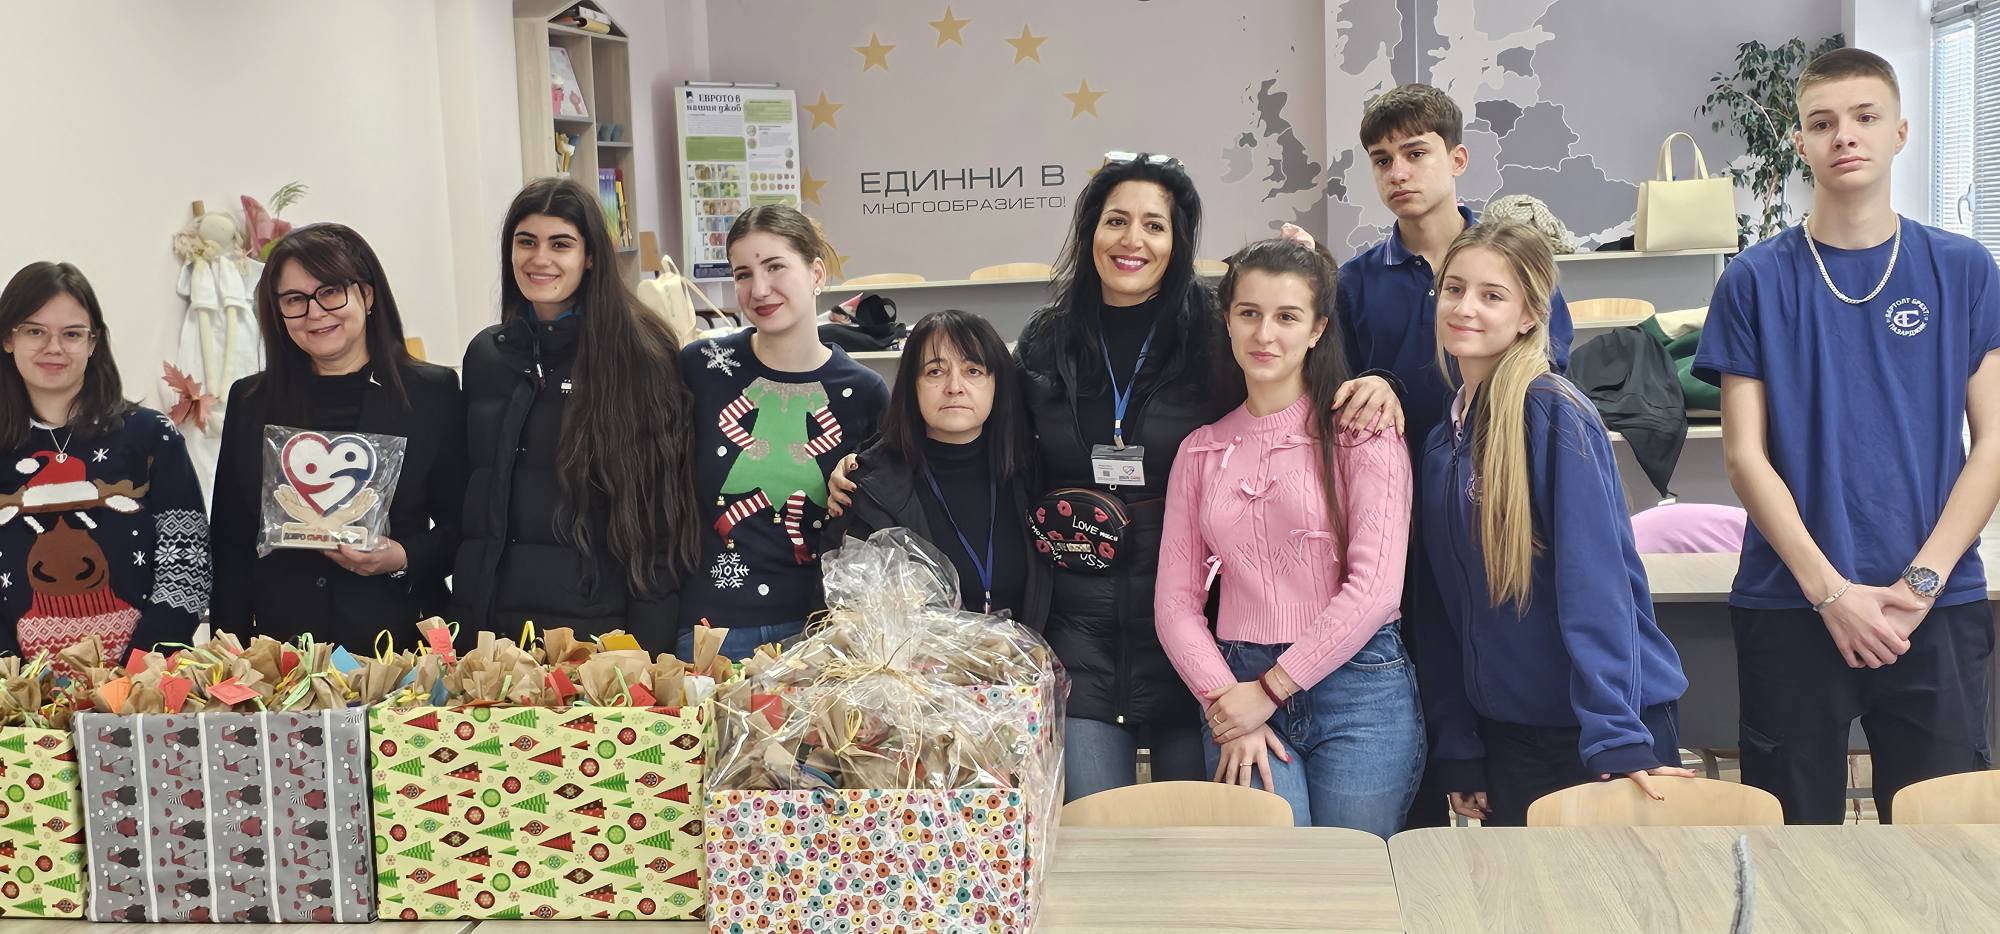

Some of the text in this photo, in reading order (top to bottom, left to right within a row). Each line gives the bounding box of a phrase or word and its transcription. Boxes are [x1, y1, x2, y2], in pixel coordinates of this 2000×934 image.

[718, 103, 742, 113] джоб
[861, 164, 1065, 198] ЕДИННИ В
[863, 196, 1066, 215] МНОГООБРАЗИЕТО!
[1072, 515, 1099, 535] LOVE
